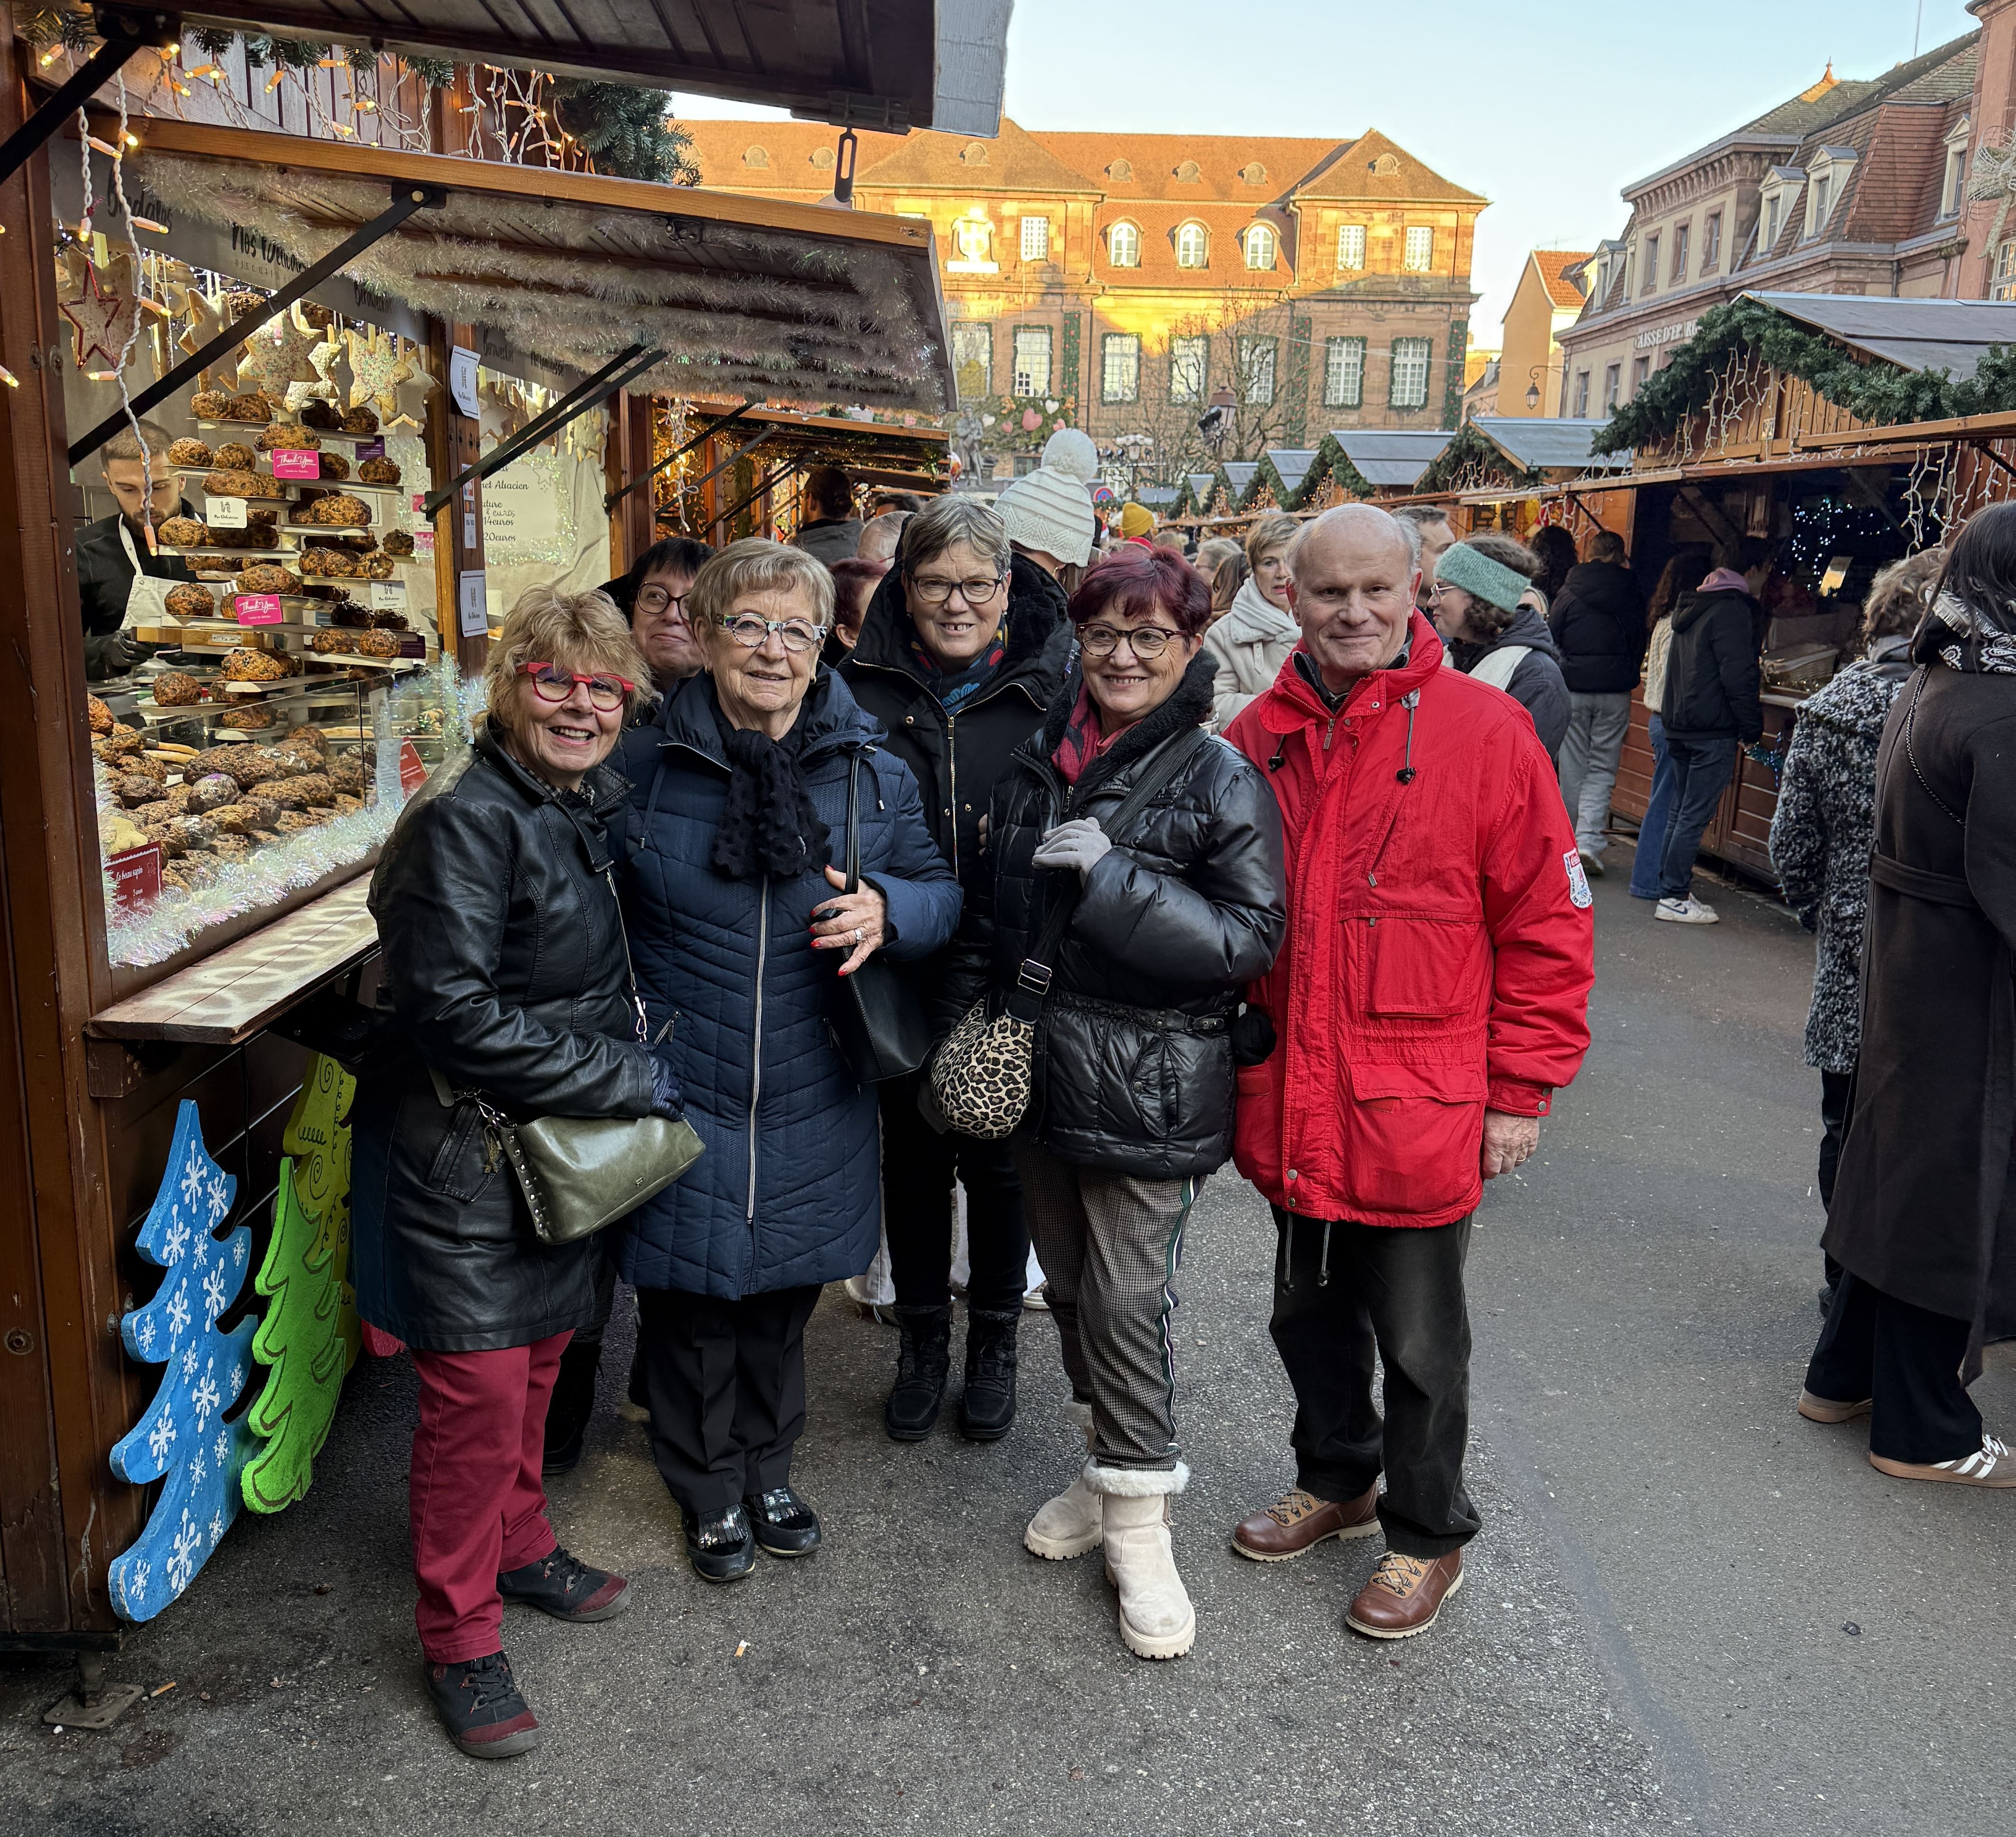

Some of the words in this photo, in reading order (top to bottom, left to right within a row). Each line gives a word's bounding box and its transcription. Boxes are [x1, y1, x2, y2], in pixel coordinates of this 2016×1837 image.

[232, 222, 256, 258] Nos
[276, 454, 298, 464] Thank
[495, 480, 529, 490] Alsacien
[238, 600, 260, 612] Thank
